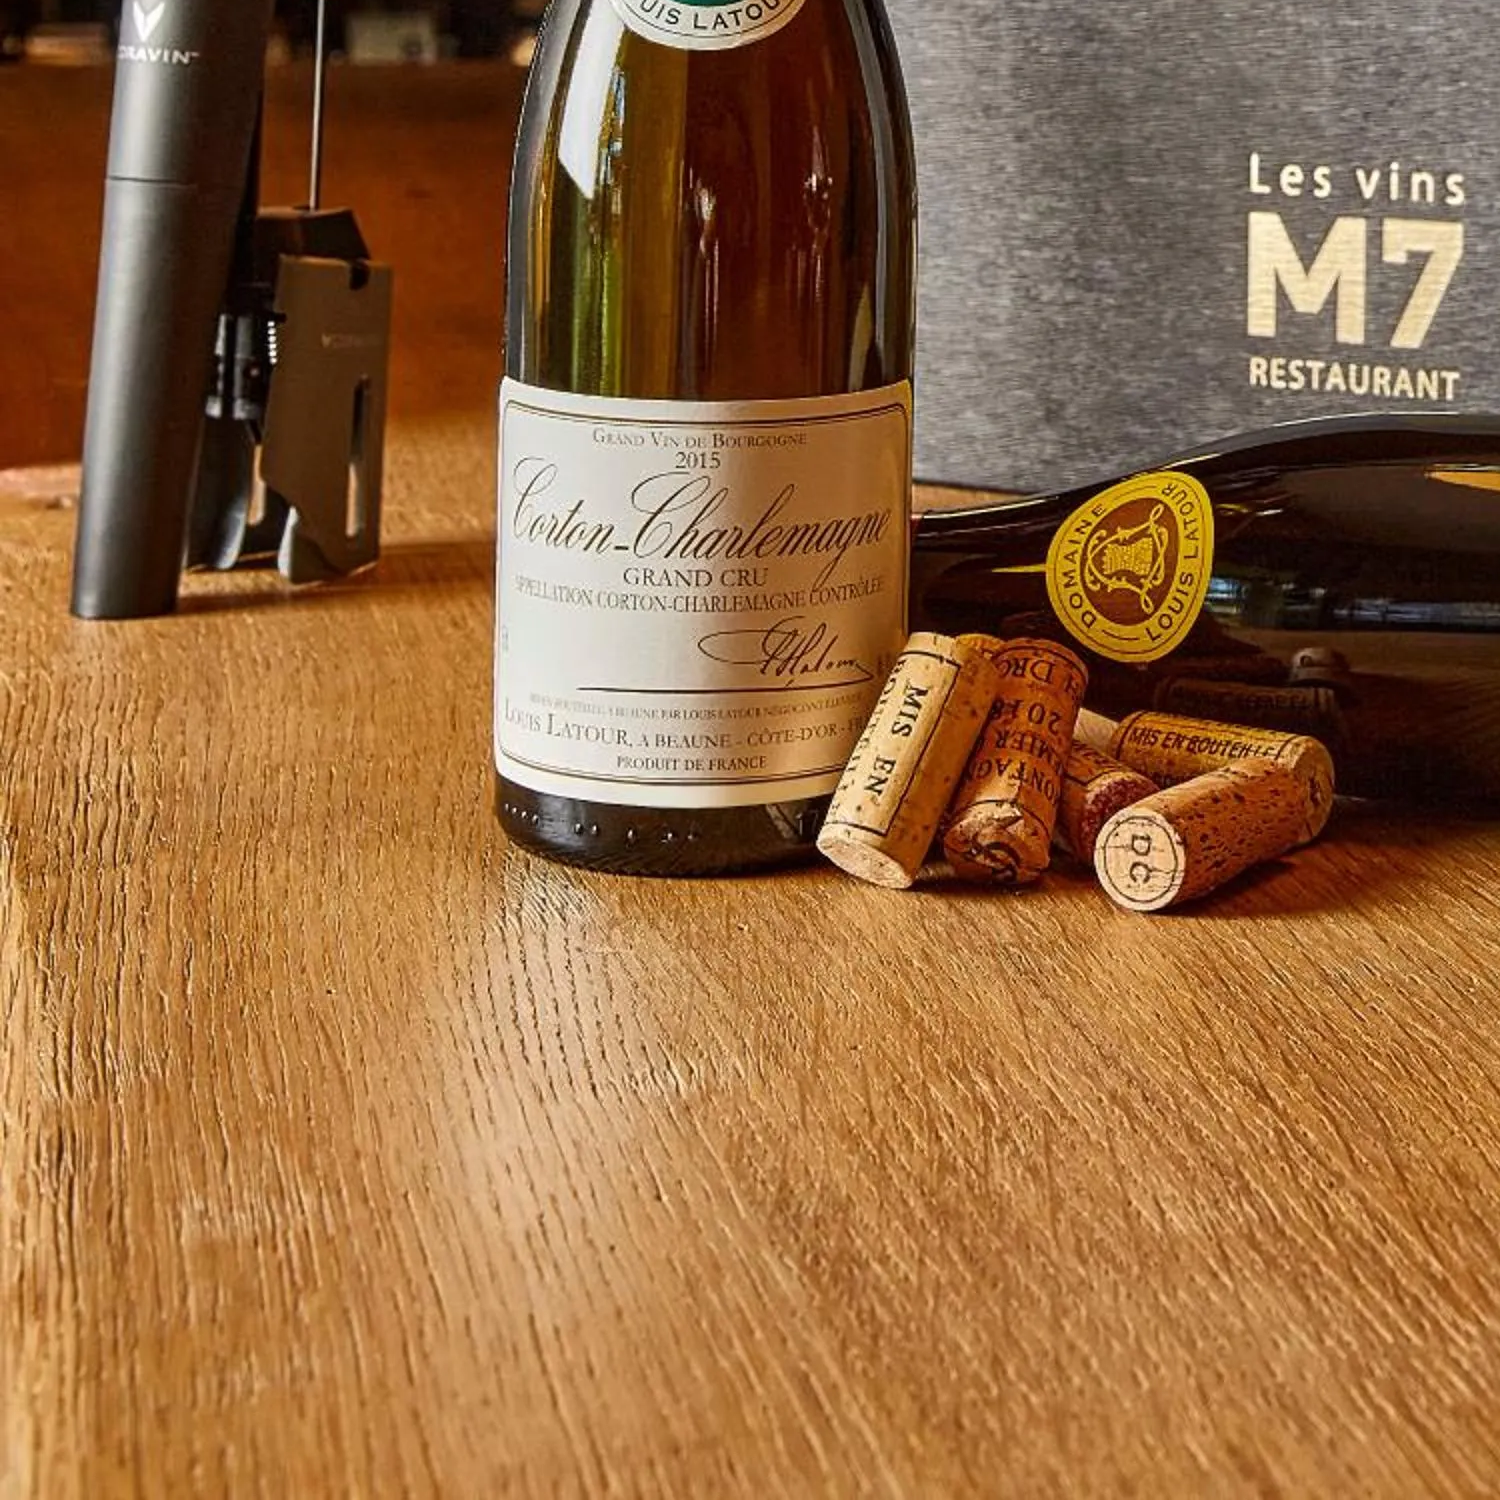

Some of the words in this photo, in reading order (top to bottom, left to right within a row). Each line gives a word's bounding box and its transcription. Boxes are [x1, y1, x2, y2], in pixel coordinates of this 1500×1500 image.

[1249, 152, 1332, 198] Les
[1355, 161, 1466, 206] vins
[1247, 211, 1465, 350] M7
[1249, 356, 1461, 401] RESTAURANT
[592, 427, 645, 446] GRAND
[650, 431, 680, 447] VIN
[712, 432, 808, 449] BOURGOGNE
[674, 451, 722, 469] 2015
[1161, 482, 1200, 561] LATOUR
[622, 566, 714, 588] GRAND
[719, 566, 769, 588] CRU
[1062, 502, 1106, 629] DOMAINE
[596, 588, 807, 614] CORTON-CHARLEMAGNE
[1145, 571, 1195, 642] LOUIS
[504, 697, 542, 733] LOUIS
[654, 733, 732, 750] BEAUNE
[890, 679, 929, 738] MIS
[616, 755, 682, 772] PRODUIT
[684, 758, 706, 772] DE
[708, 755, 767, 772] FRANCE
[863, 754, 897, 798] EN
